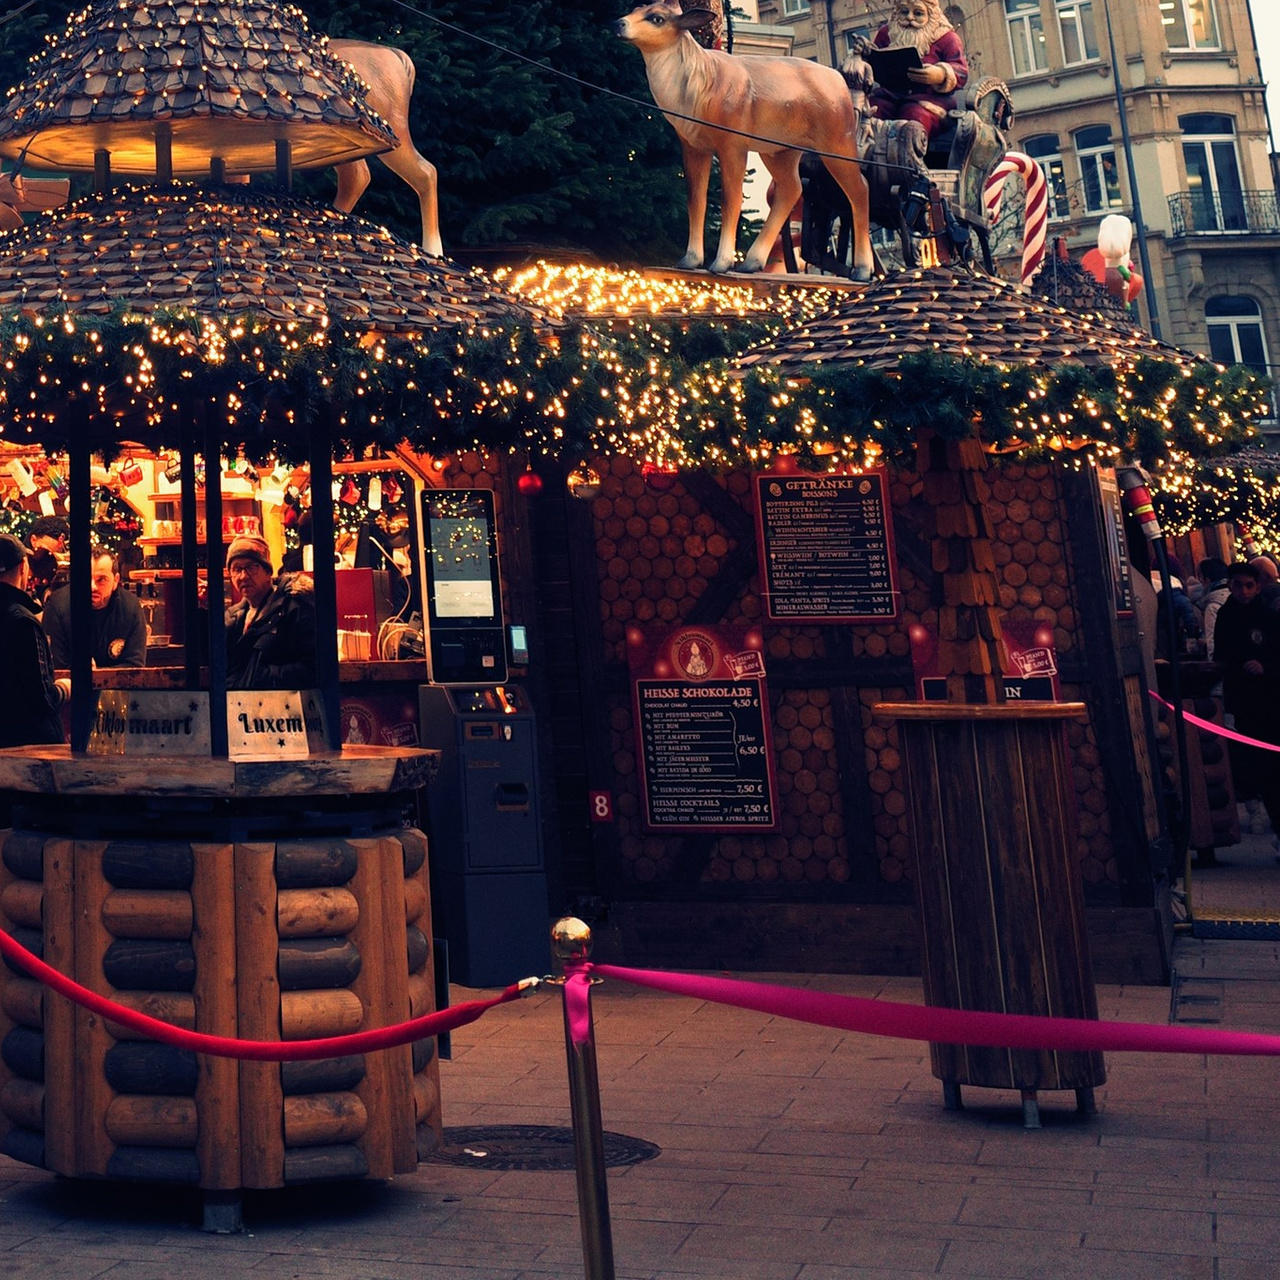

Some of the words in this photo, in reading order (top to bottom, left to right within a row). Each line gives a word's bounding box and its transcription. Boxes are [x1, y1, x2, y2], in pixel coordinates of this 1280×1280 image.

[785, 478, 854, 491] GETRÄNKE
[801, 490, 838, 498] BOISSONS
[643, 688, 680, 699] HEISSE
[682, 687, 753, 699] SCHOKOLADE
[732, 699, 751, 709] 4,50
[753, 699, 759, 708] €
[238, 713, 324, 737] Luxem
[739, 746, 758, 755] 6,50
[759, 746, 766, 755] €
[736, 784, 755, 794] 7,50
[757, 784, 763, 793] €
[595, 795, 609, 817] 8
[743, 804, 762, 814] 7,50
[763, 804, 769, 813] €
